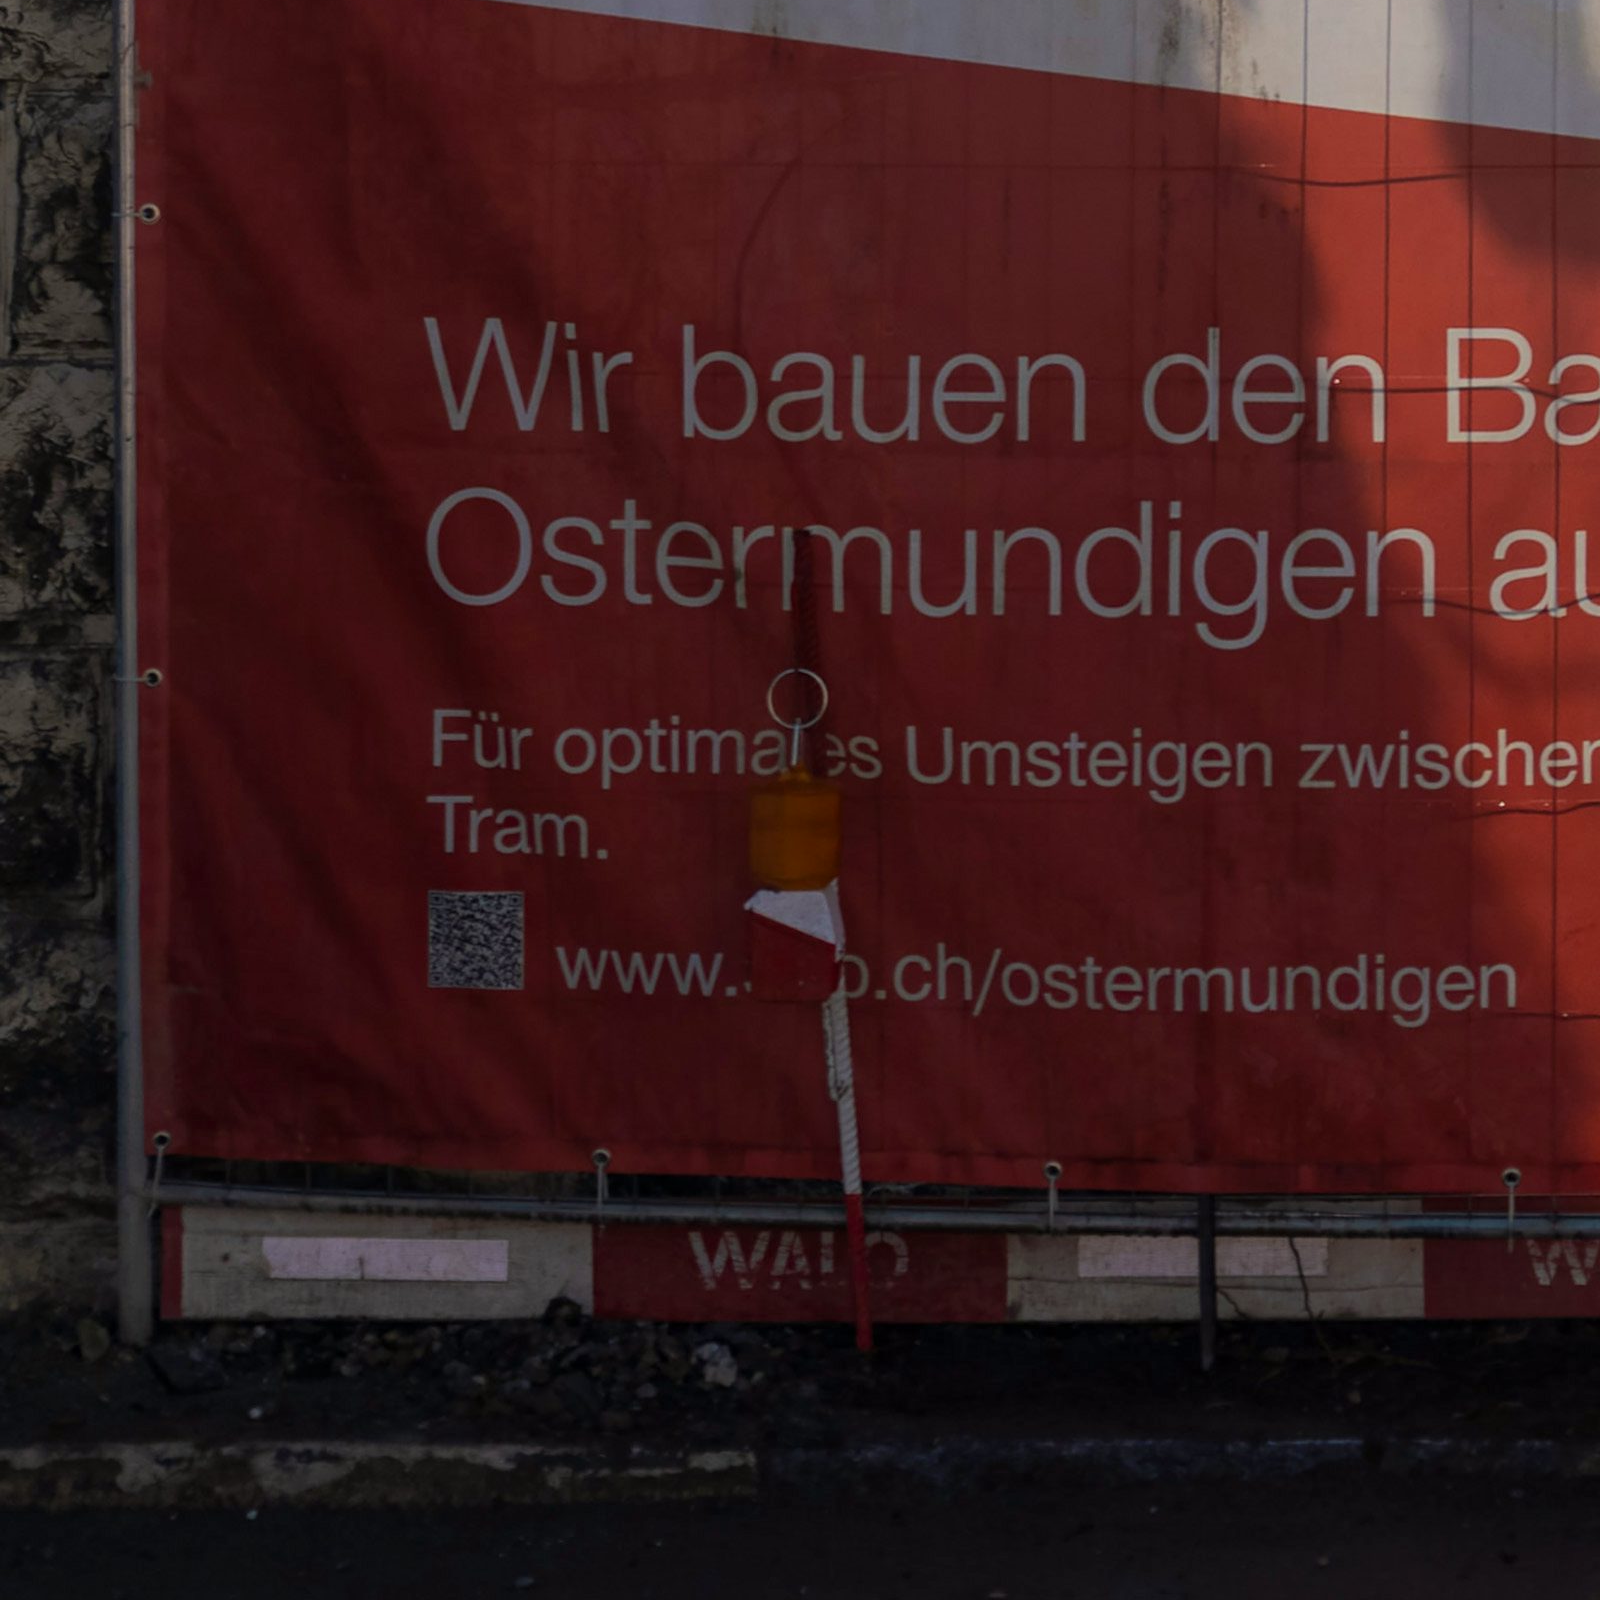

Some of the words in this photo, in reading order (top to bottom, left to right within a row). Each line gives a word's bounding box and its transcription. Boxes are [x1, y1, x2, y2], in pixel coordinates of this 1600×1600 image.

[424, 317, 632, 432] Wir
[683, 324, 1085, 444] bauen
[1143, 327, 1385, 444] den
[426, 487, 1435, 650] Ostermundigen
[433, 709, 533, 770] Für
[554, 715, 882, 789] optimaes
[906, 726, 1273, 804] Umsteigen
[427, 796, 609, 859] Tram.
[556, 943, 1517, 1028] www..ch/ostermundigen
